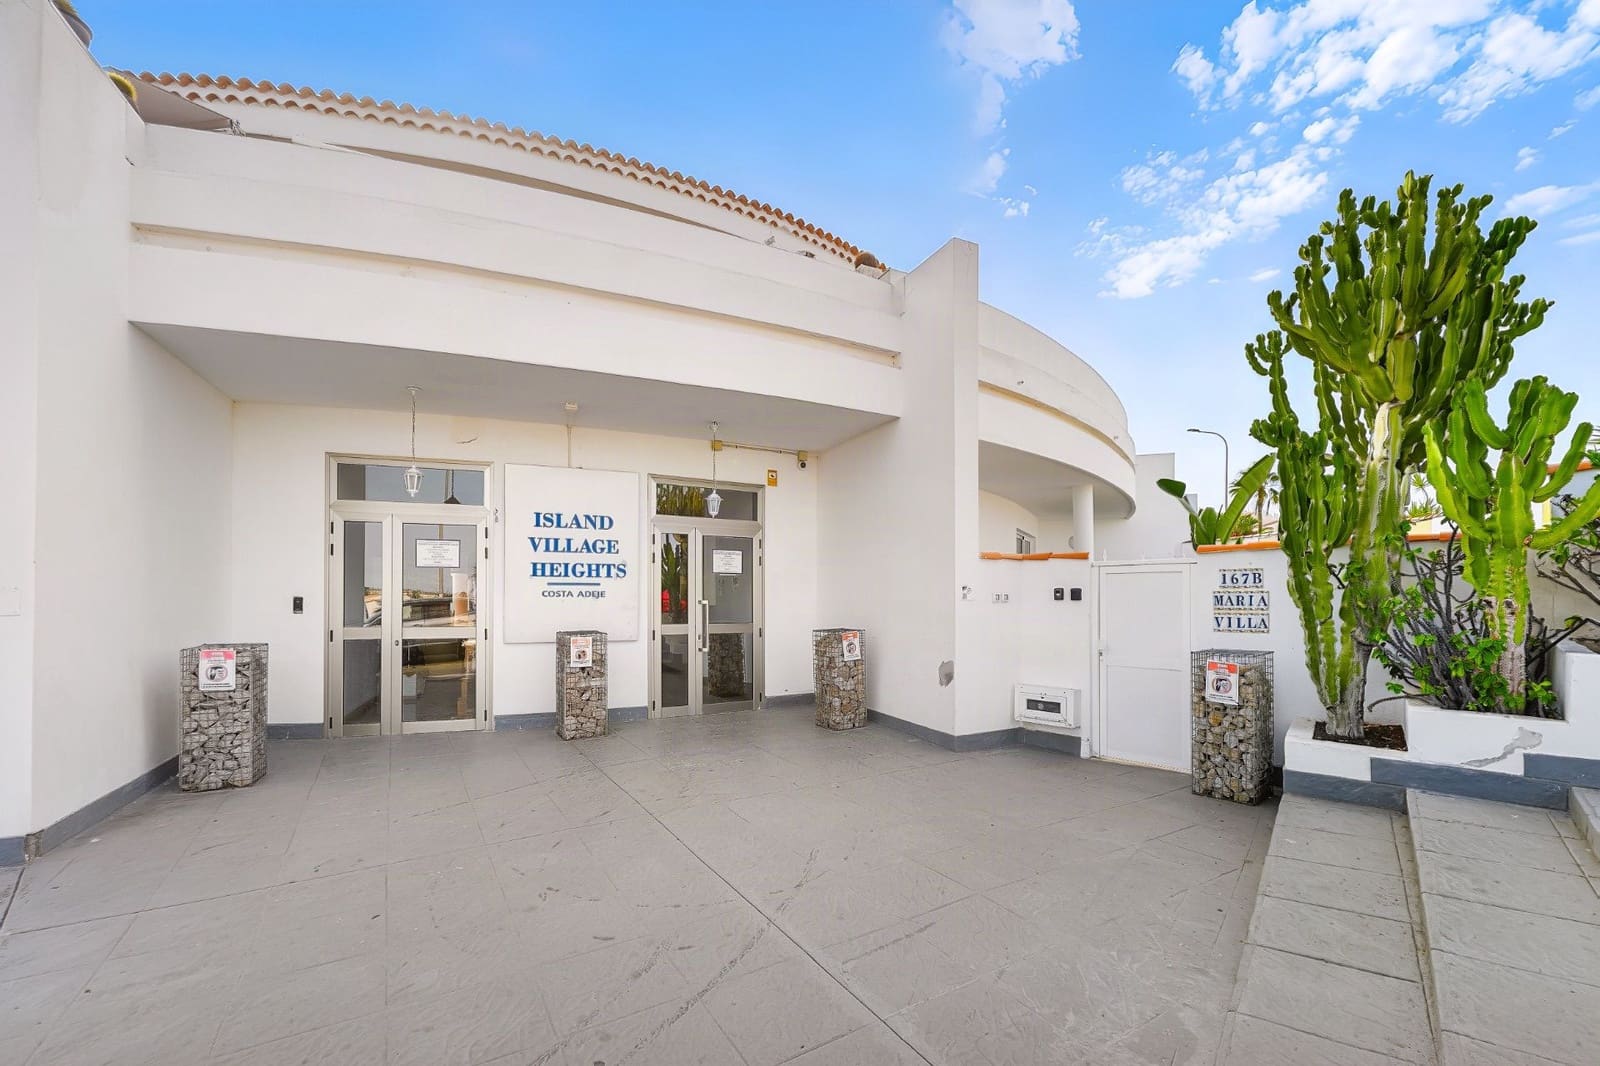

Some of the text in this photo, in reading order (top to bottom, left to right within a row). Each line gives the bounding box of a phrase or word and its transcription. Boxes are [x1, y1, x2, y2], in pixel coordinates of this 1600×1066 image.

[533, 511, 614, 531] ISLAND
[528, 536, 619, 554] VILLAGE
[530, 562, 627, 579] HEIGHTS
[1221, 572, 1262, 584] 167B
[541, 590, 606, 599] COSTA ADEJE
[1213, 595, 1267, 606] MARIA
[1214, 616, 1268, 629] VILLA
